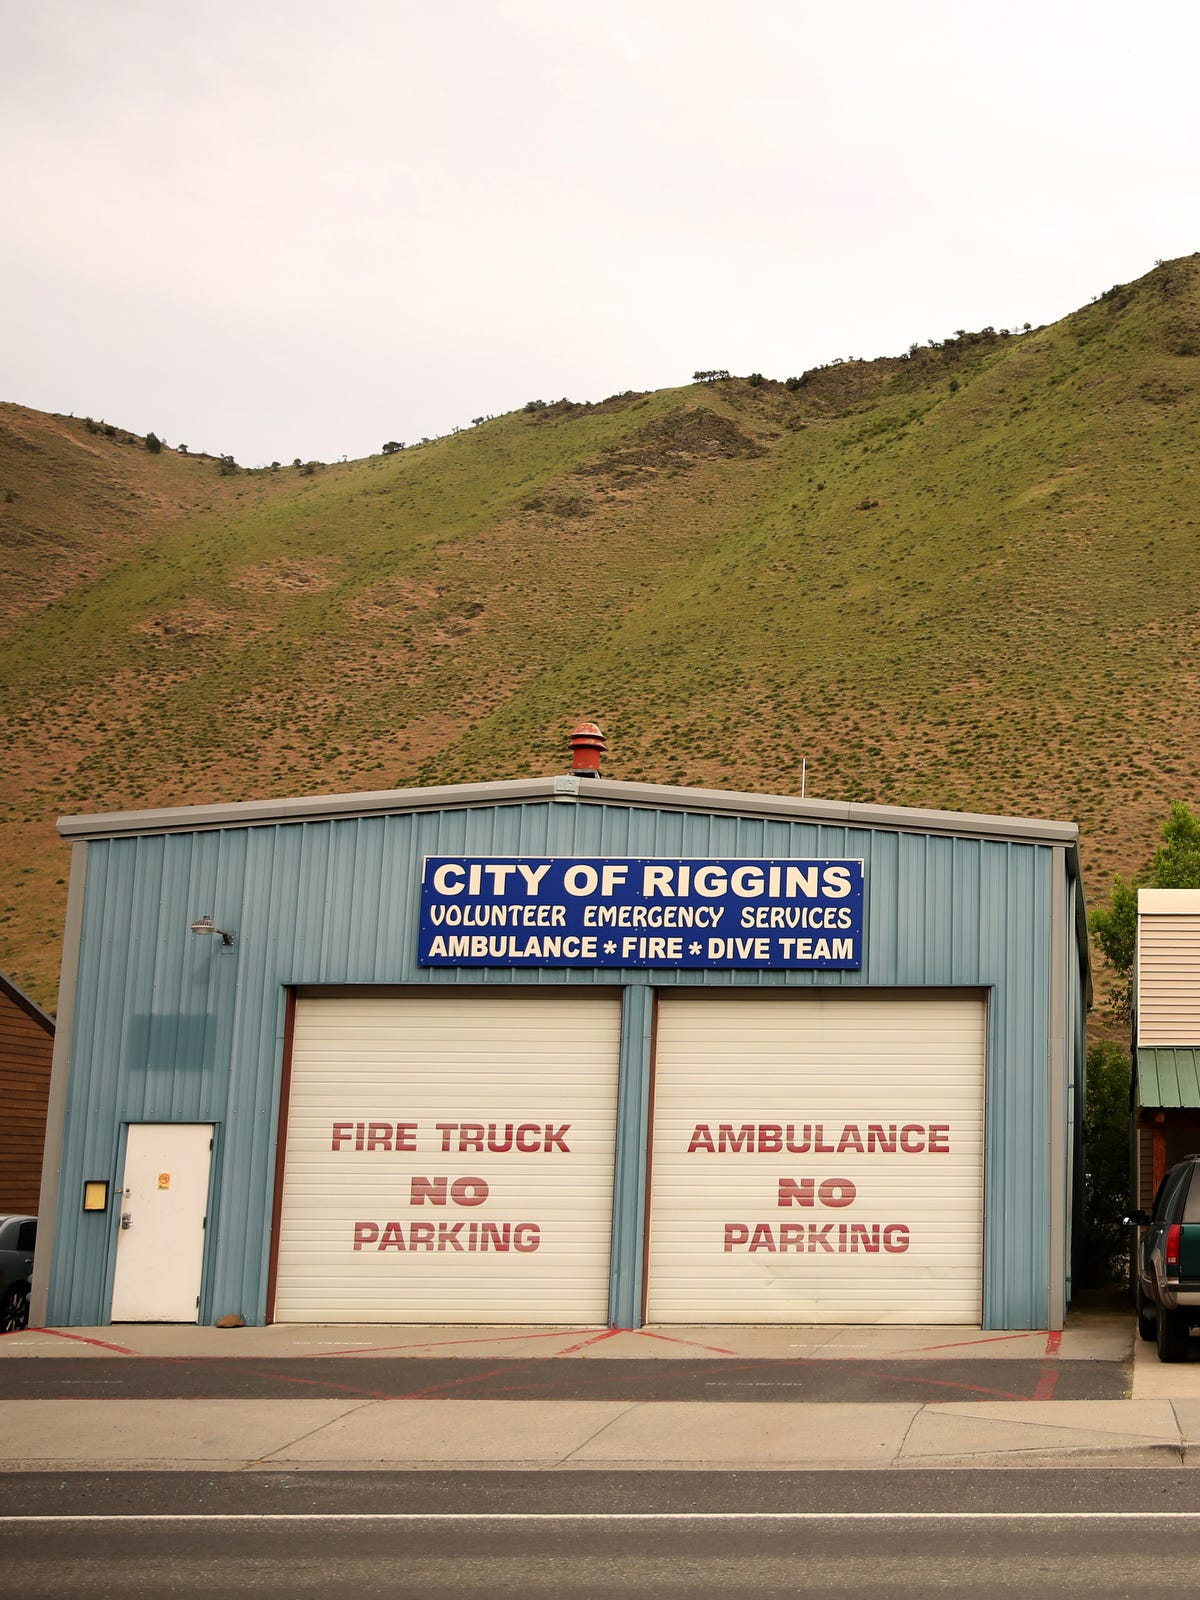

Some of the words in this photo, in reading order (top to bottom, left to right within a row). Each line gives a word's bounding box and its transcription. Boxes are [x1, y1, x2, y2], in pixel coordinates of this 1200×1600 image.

[433, 864, 551, 896] CITY
[563, 865, 629, 897] OF
[643, 866, 852, 898] RIGGINS
[430, 904, 566, 927] VOLUNTEER
[583, 905, 725, 928] EMERGENCY
[740, 906, 852, 929] SERVICES
[428, 936, 598, 958] AMBULANCE
[622, 937, 683, 959] FIRE
[707, 938, 771, 960] DIVE
[778, 938, 853, 960] TEAM
[331, 1122, 418, 1152] FIRE
[434, 1123, 572, 1153] TRUCK
[687, 1124, 951, 1154] AMBULANCE
[410, 1176, 490, 1207] NO
[777, 1178, 857, 1208] NO
[353, 1222, 541, 1253] PARKING
[723, 1223, 911, 1254] PARKING
